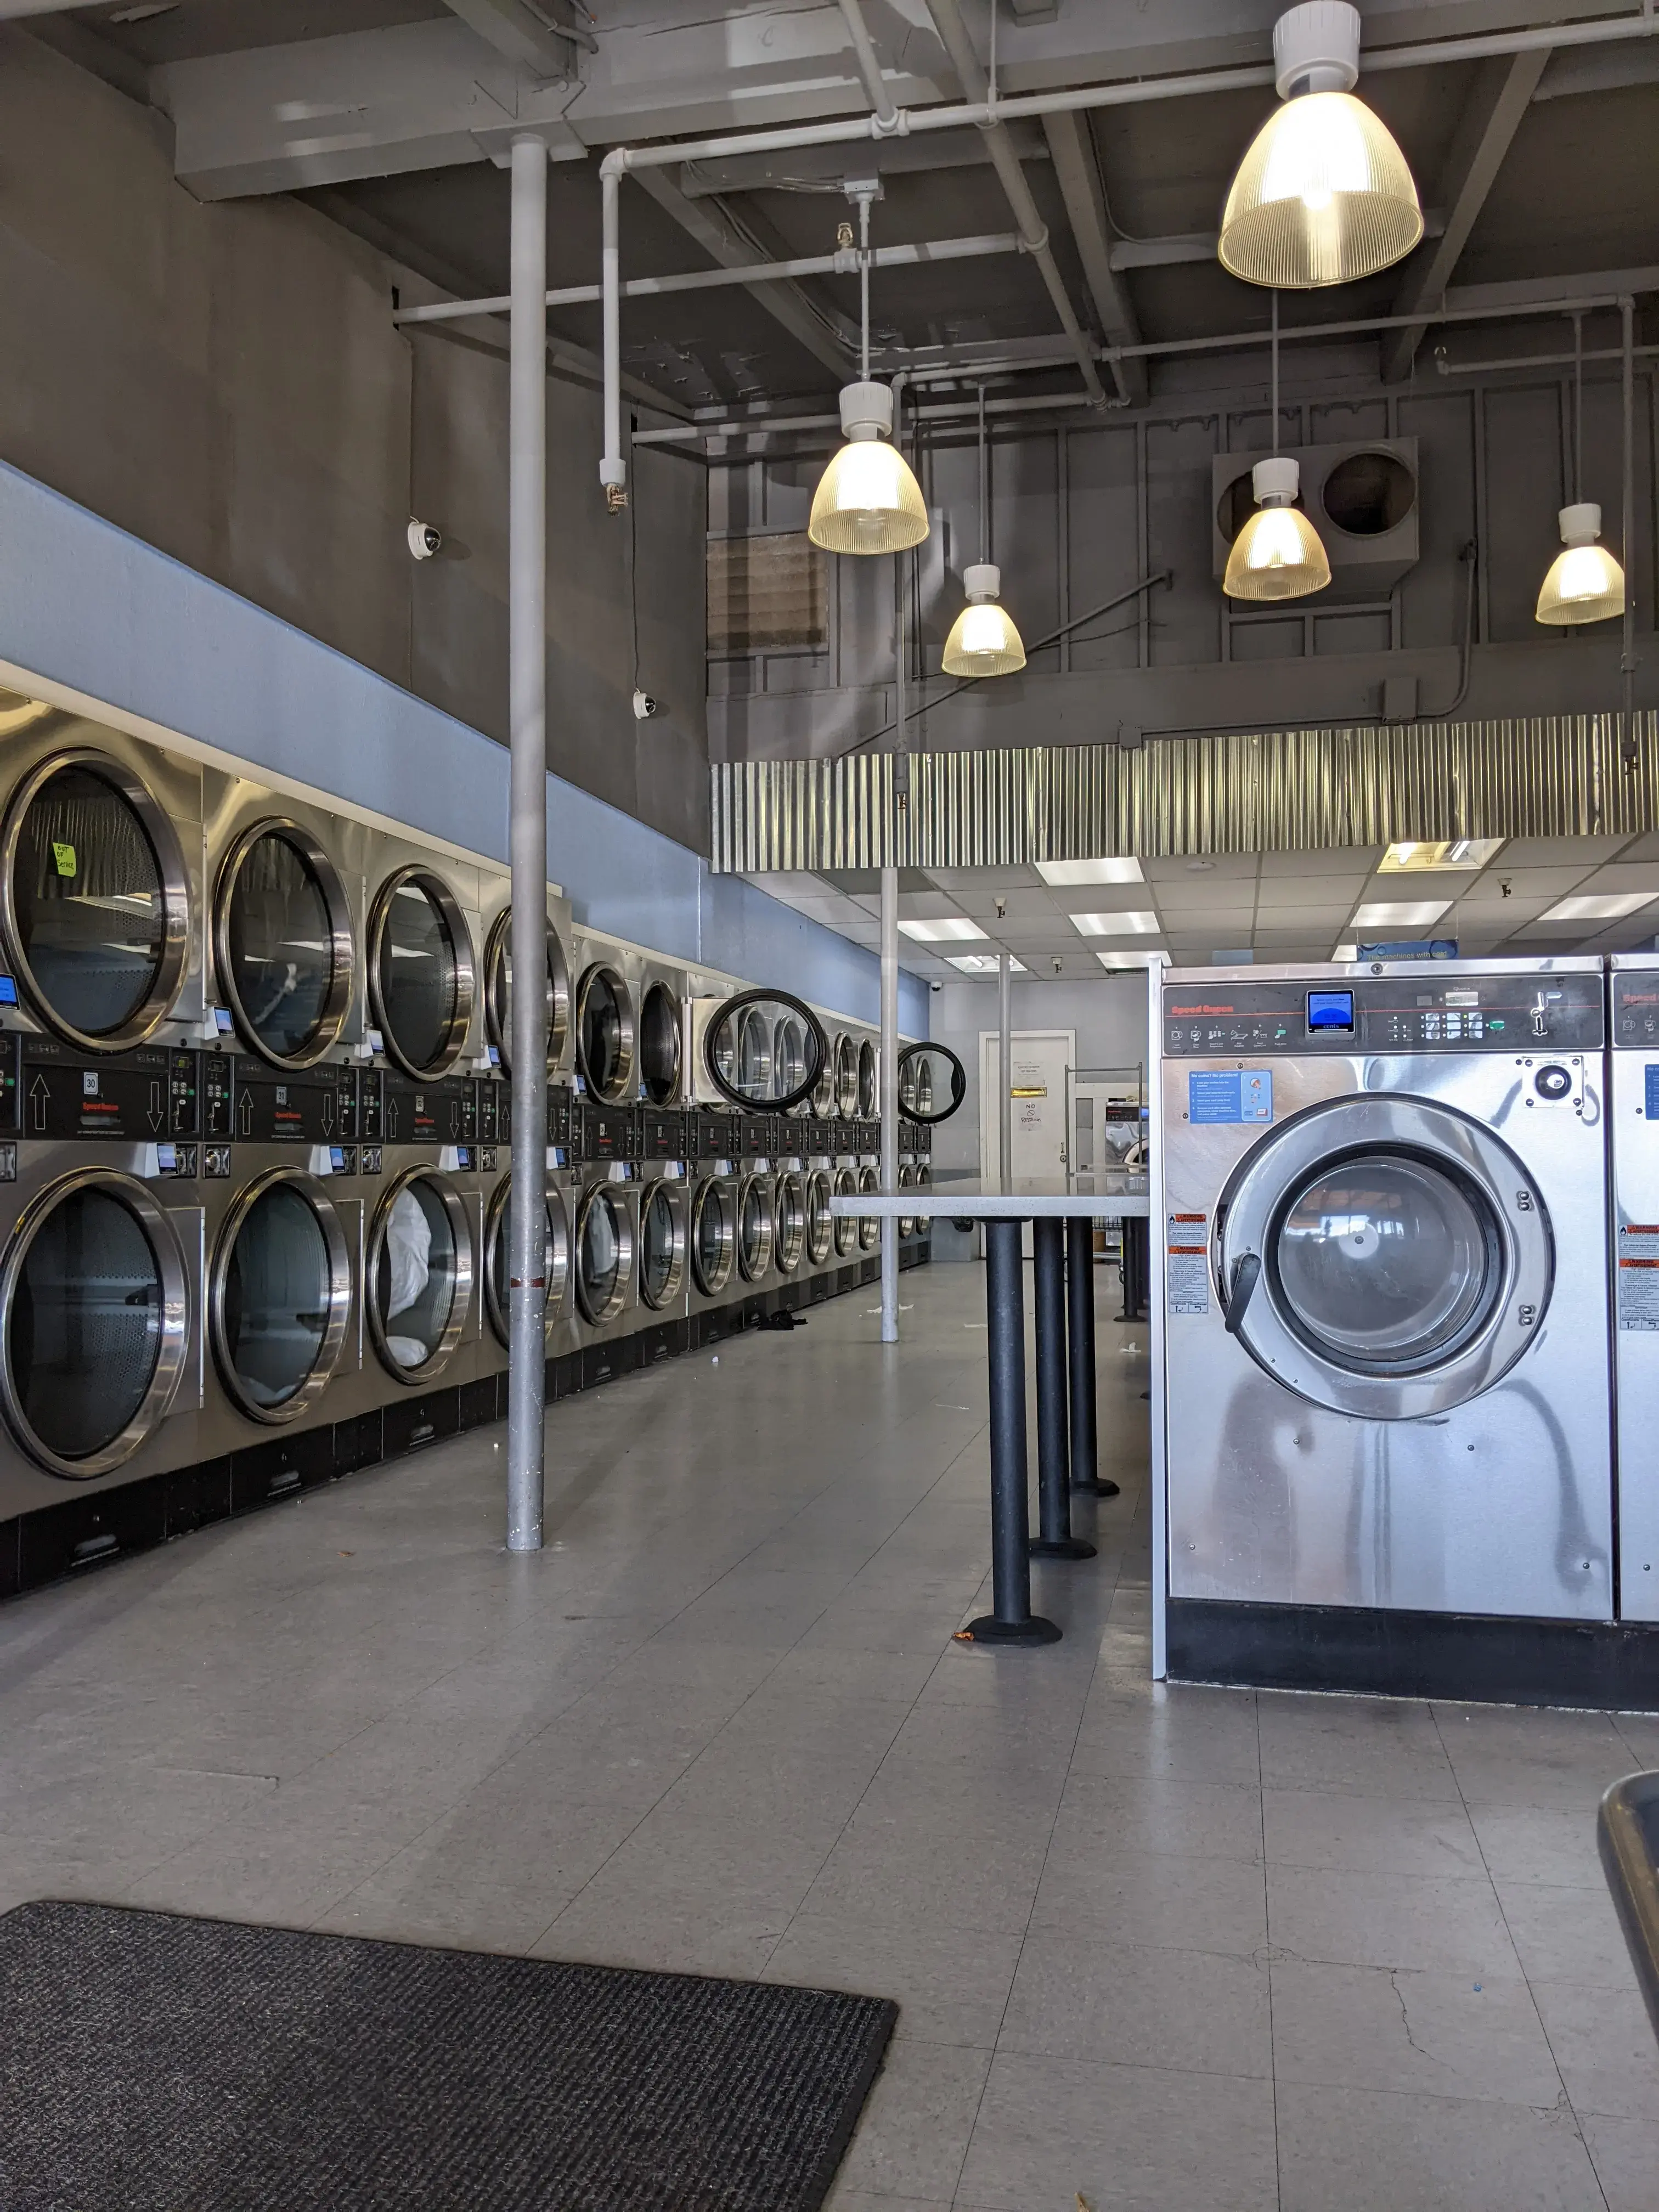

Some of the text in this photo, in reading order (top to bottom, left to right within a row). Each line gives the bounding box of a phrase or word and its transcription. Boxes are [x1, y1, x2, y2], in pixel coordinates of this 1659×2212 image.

[1171, 1005, 1234, 1014] Speed Queen
[87, 1079, 95, 1088] 30
[279, 1091, 285, 1099] 31
